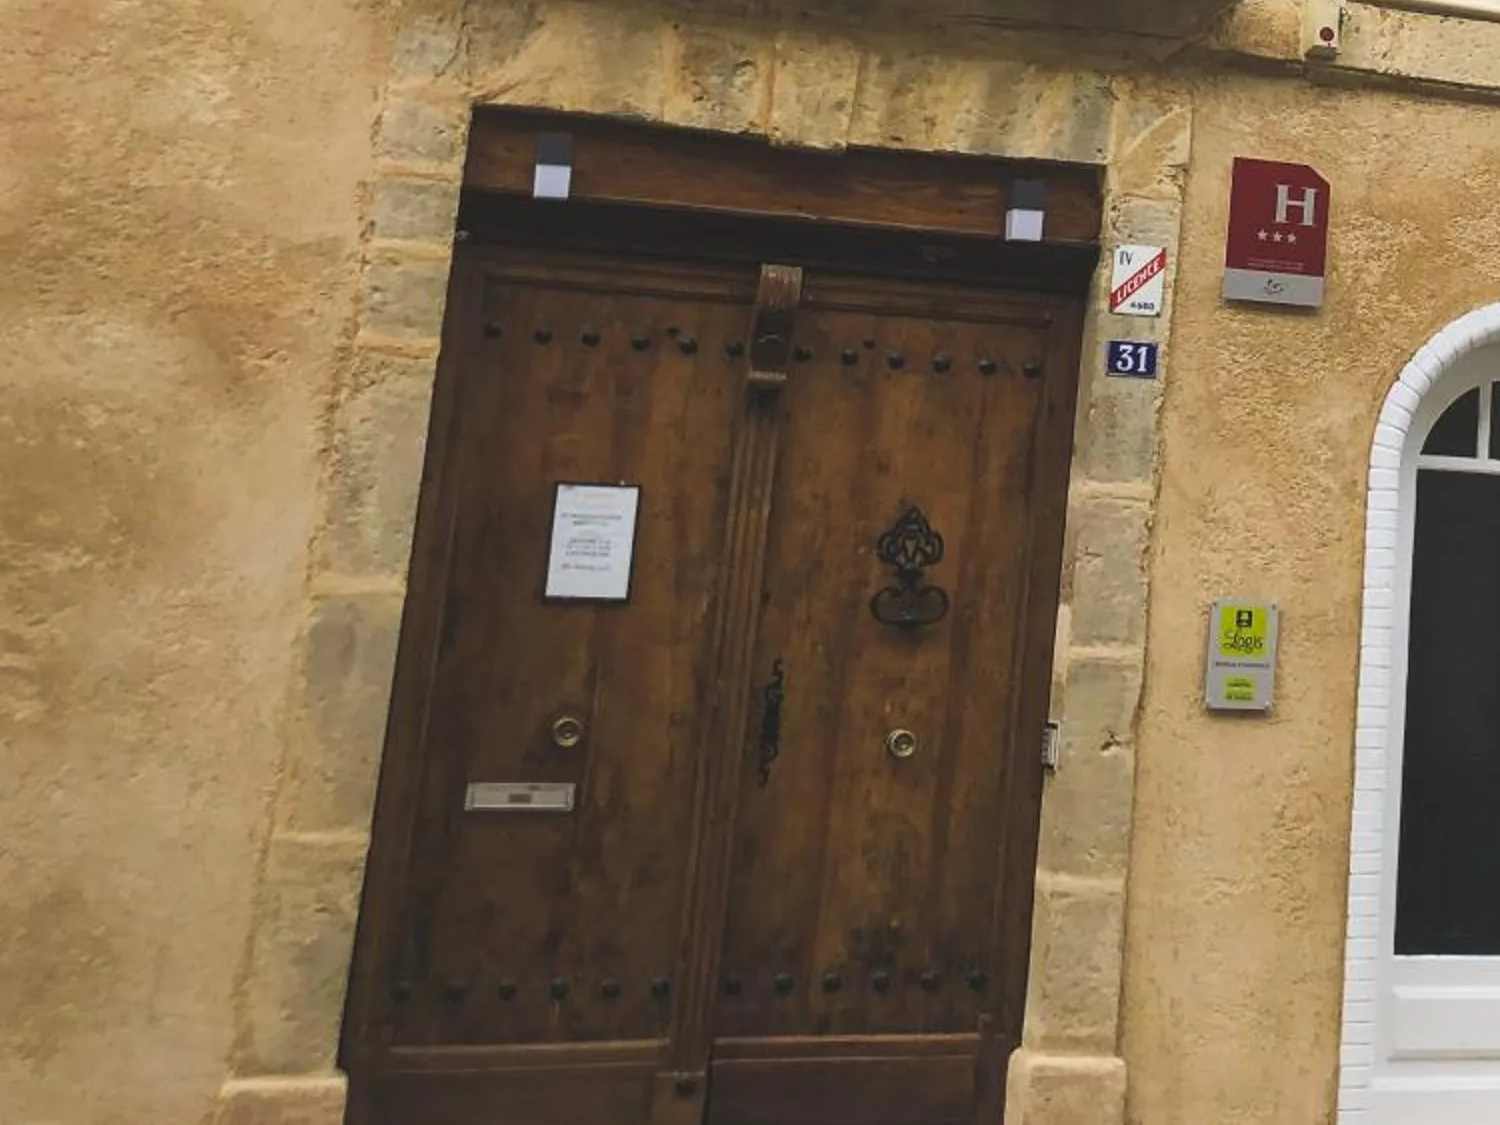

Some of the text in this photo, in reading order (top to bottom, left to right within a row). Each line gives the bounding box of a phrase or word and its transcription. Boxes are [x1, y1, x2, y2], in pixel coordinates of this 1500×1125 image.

[1273, 183, 1318, 226] H
[1119, 250, 1133, 266] IV
[1116, 257, 1162, 303] LICENCE
[1116, 344, 1148, 372] 31
[1222, 629, 1263, 654] Logis
